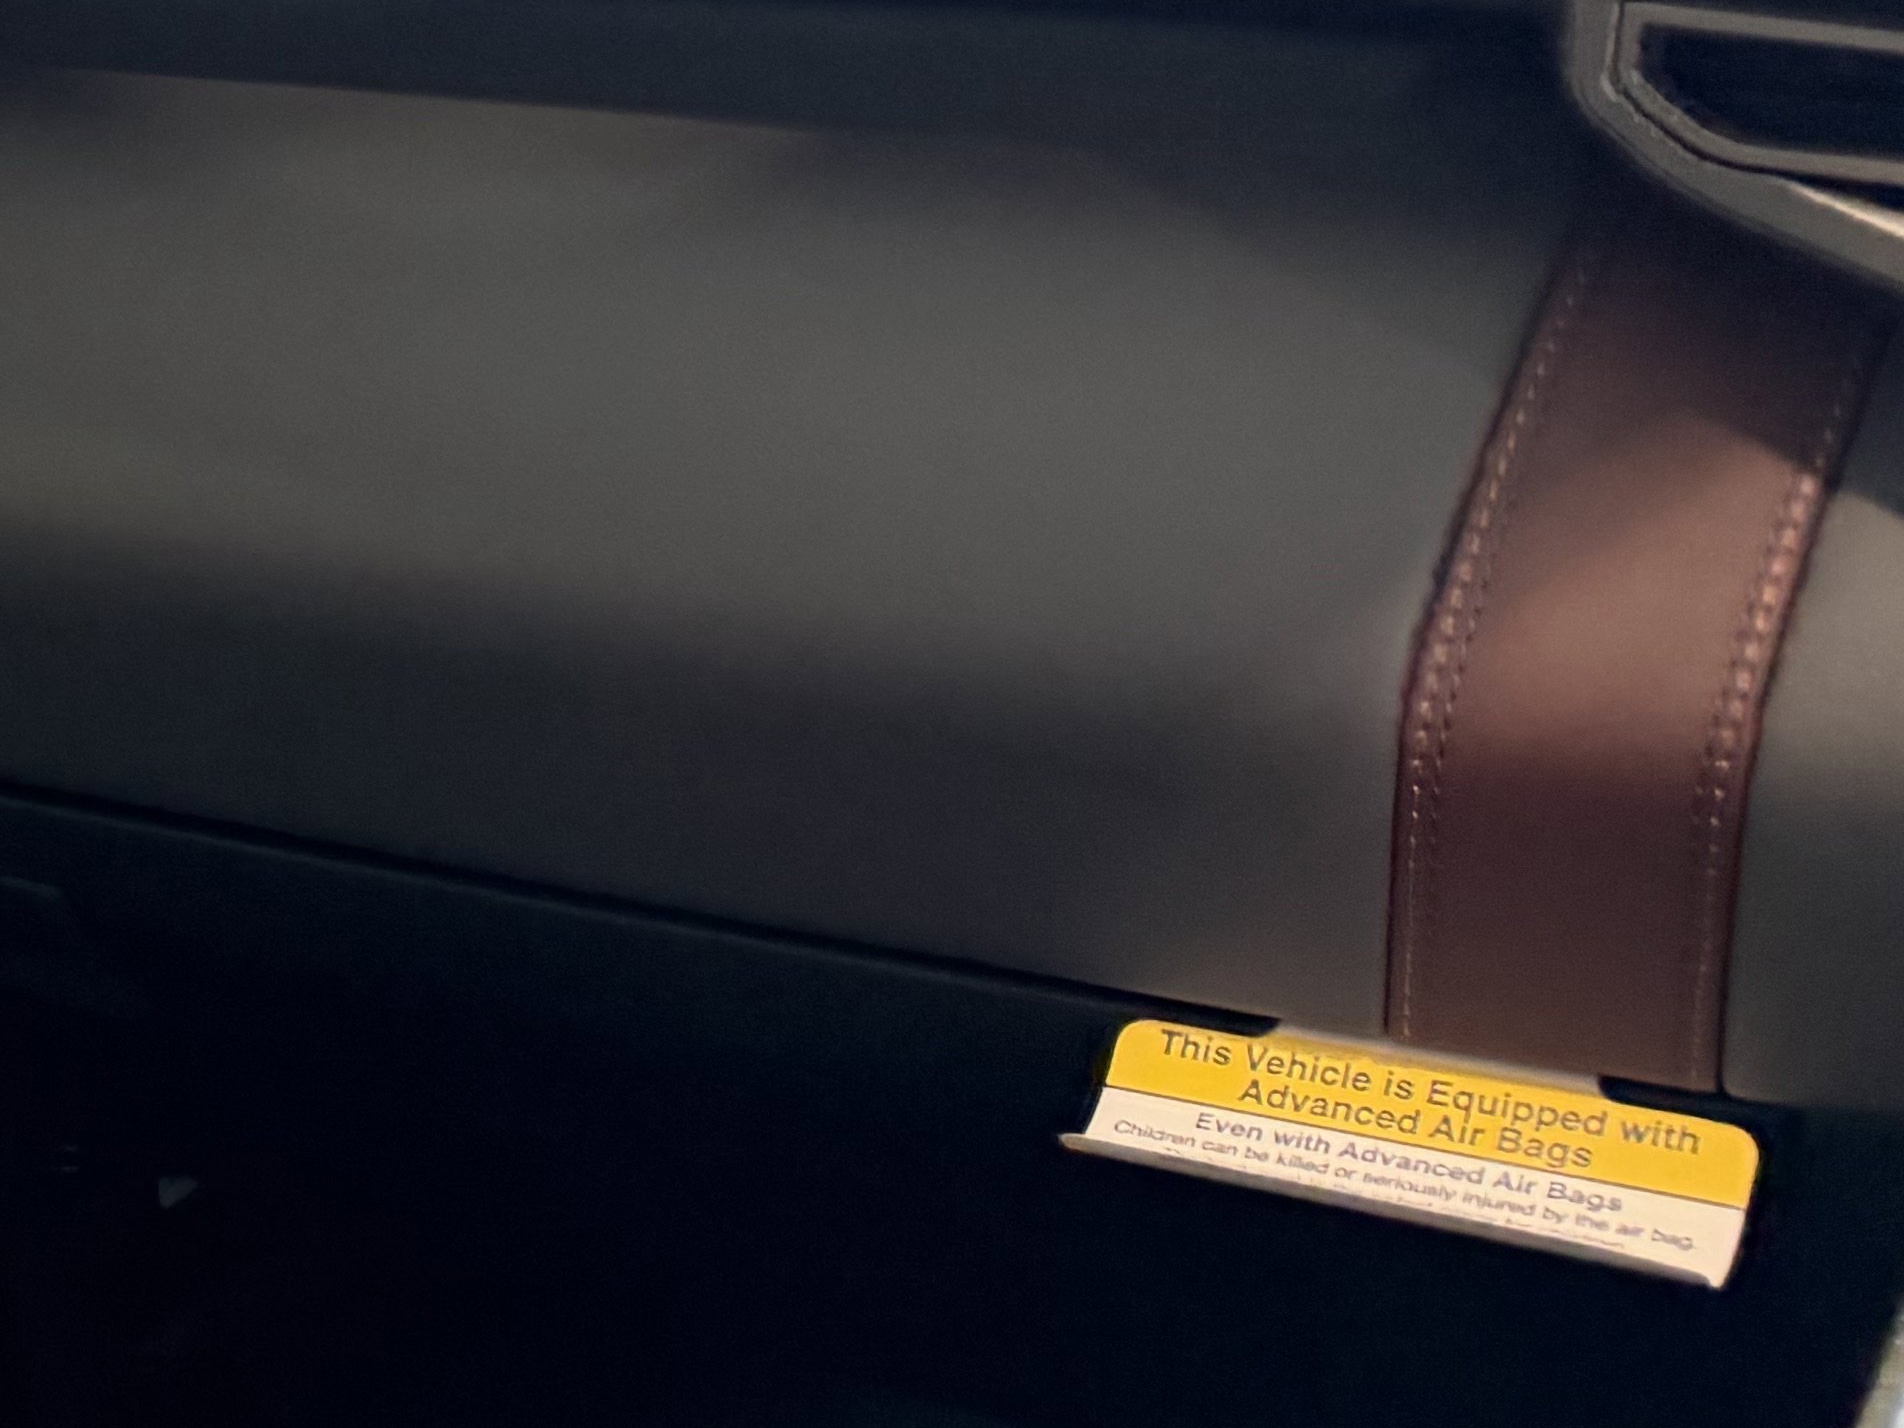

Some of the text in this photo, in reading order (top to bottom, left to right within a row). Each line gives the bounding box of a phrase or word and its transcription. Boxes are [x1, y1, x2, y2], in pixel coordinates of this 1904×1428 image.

[1160, 1027, 1703, 1156] This Vehicle is Equipped with
[1237, 1078, 1594, 1170] Advanced Air Bags
[1113, 1118, 1197, 1149] Children
[1201, 1139, 1239, 1158] can
[1245, 1145, 1271, 1163] be
[1275, 1153, 1331, 1177] killed
[1334, 1164, 1356, 1180] or
[1361, 1171, 1458, 1203] seriously
[1461, 1187, 1537, 1217] injured
[1541, 1206, 1571, 1226] by
[1574, 1210, 1611, 1233] the
[1614, 1221, 1645, 1237] air
[1195, 1111, 1624, 1213] Even with Advanced Air Bags
